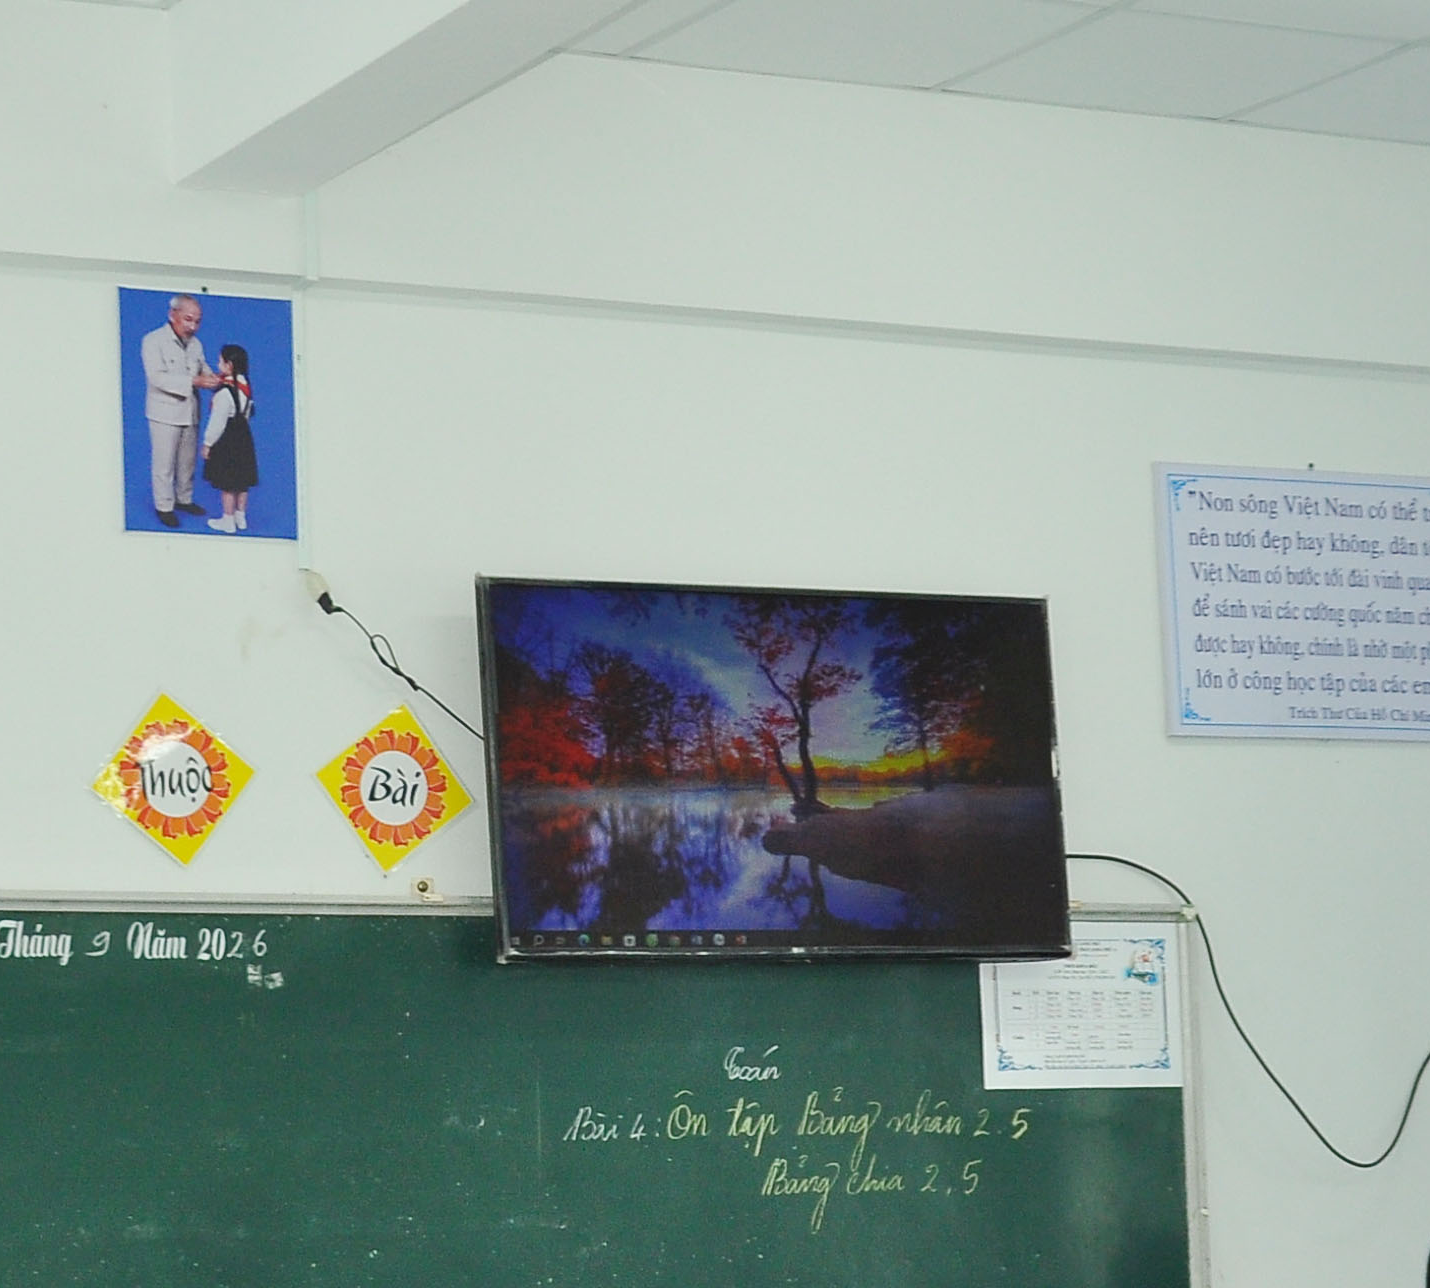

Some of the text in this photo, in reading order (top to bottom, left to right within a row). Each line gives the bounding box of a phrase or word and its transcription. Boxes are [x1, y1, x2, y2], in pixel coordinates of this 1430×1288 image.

[1239, 493, 1279, 520] sông
[1282, 494, 1321, 520] Việt
[1324, 496, 1364, 519] Nam
[1368, 500, 1388, 520] có
[1391, 497, 1417, 522] thể
[1189, 527, 1221, 547] nên
[1224, 528, 1257, 548] tươi
[1261, 529, 1293, 556] đẹp
[1296, 530, 1325, 557] hay
[1389, 535, 1420, 556] dân
[1190, 561, 1224, 587] Việt
[1226, 563, 1262, 584] Nam
[1264, 564, 1283, 585] có
[1285, 565, 1322, 586] bước
[1323, 567, 1344, 588] tới
[1347, 568, 1370, 589] đài
[1372, 569, 1405, 590] vinh
[1193, 592, 1211, 618] để
[1214, 598, 1248, 619] sánh
[1251, 599, 1273, 620] vai
[1276, 600, 1300, 621] các
[1302, 601, 1345, 629] cường
[1348, 600, 1382, 629] quốc
[1385, 606, 1416, 626] năm
[1194, 633, 1229, 658] được
[1230, 634, 1255, 660] hay
[1308, 636, 1345, 657] chính
[1346, 637, 1360, 658] là
[1362, 639, 1388, 660] nhờ
[1390, 640, 1418, 664] một
[1195, 668, 1223, 689] lớn
[1227, 667, 1239, 690] ở
[1242, 670, 1283, 696] công
[1285, 670, 1316, 696] học
[1319, 672, 1346, 698] tập
[1348, 671, 1378, 693] của
[1381, 674, 1408, 694] các
[137, 756, 214, 803] Thuộc
[368, 766, 423, 808] Bài
[84, 930, 111, 957] 9
[126, 921, 189, 960] Năm
[724, 1044, 782, 1082] Toán
[562, 1104, 624, 1142] Bài
[667, 1089, 709, 1140] Ôn
[726, 1097, 780, 1158] tập
[797, 1086, 882, 1173] Bảng
[886, 1089, 962, 1136] nhân
[761, 1154, 842, 1235] Bảng
[846, 1153, 906, 1196] chia
